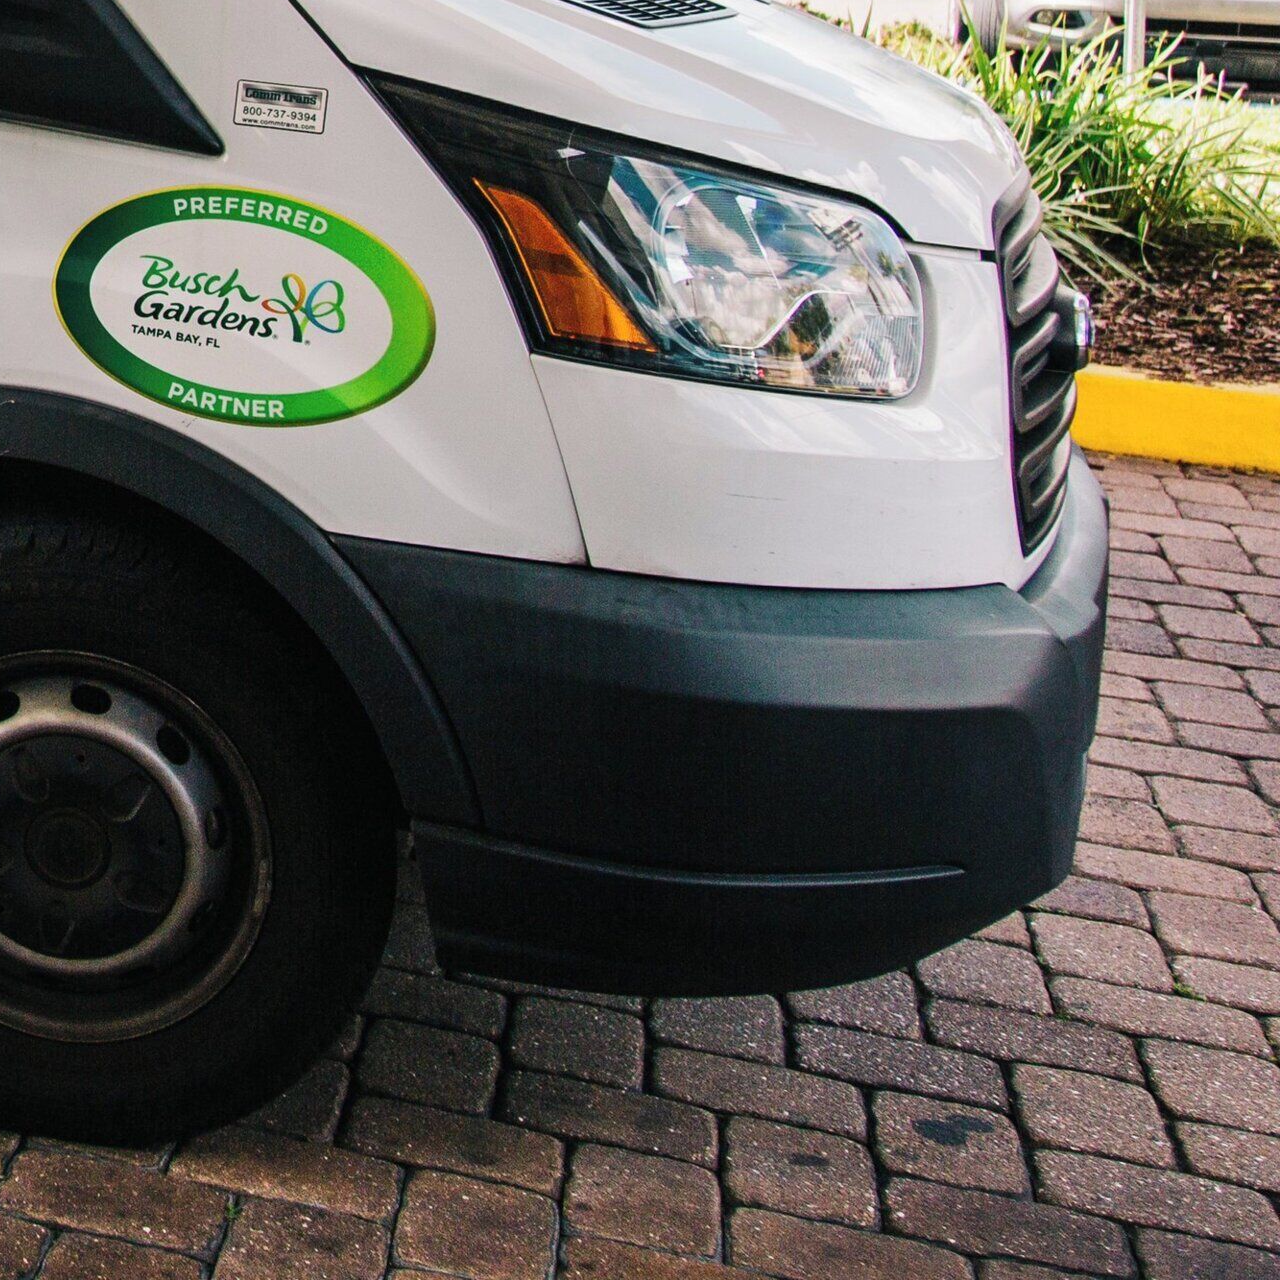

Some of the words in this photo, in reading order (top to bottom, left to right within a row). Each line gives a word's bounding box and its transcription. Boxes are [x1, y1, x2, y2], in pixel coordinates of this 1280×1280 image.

[242, 106, 317, 122] 800-737-9394
[242, 118, 316, 130] www.commtrans.com
[173, 196, 329, 236] PREFERRED
[139, 254, 261, 303] Busch
[133, 290, 277, 339] Gardens
[131, 324, 174, 341] TAMPA
[175, 330, 203, 348] BAY,
[205, 336, 221, 349] FL
[167, 383, 285, 419] PARTNER
